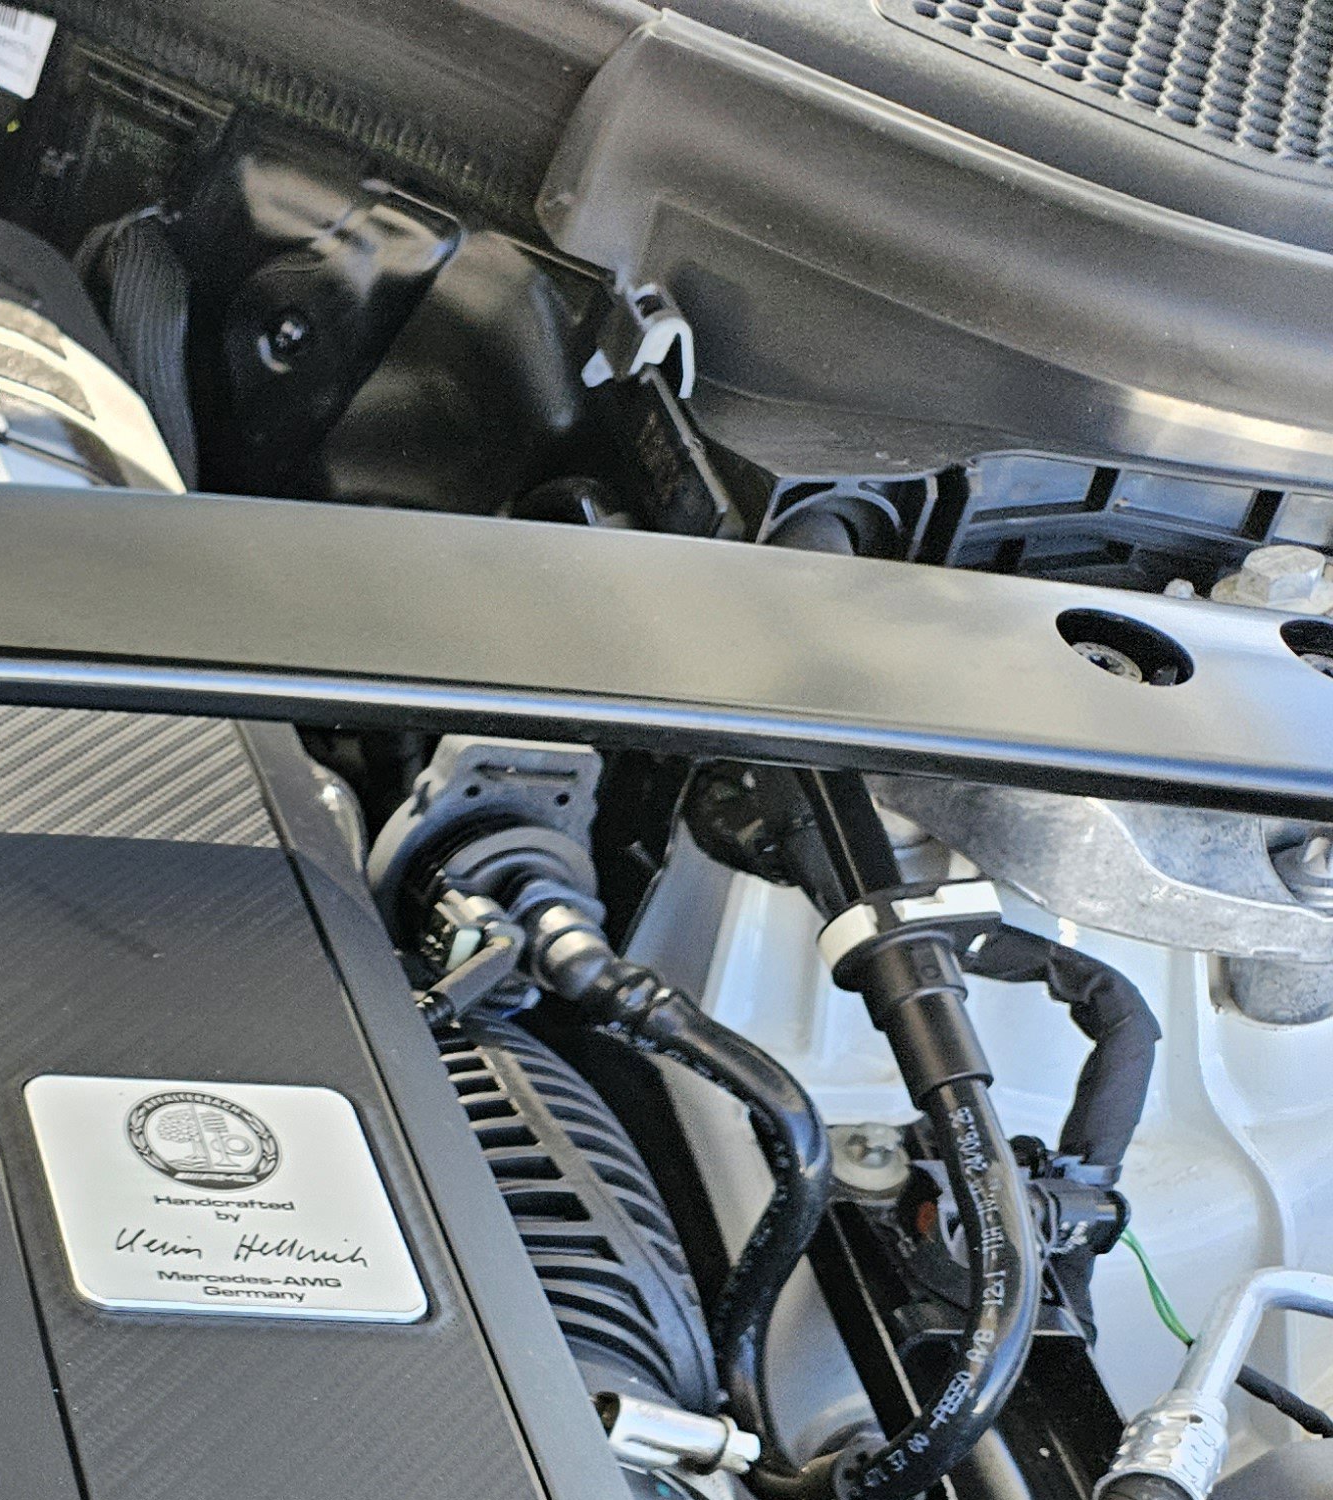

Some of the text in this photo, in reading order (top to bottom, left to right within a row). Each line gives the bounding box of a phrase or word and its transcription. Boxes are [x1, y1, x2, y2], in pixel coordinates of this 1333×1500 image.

[153, 1194, 296, 1211] Handcrafted
[214, 1210, 242, 1223] by
[156, 1269, 343, 1289] Mercedes-AMG
[203, 1285, 306, 1303] Germany
